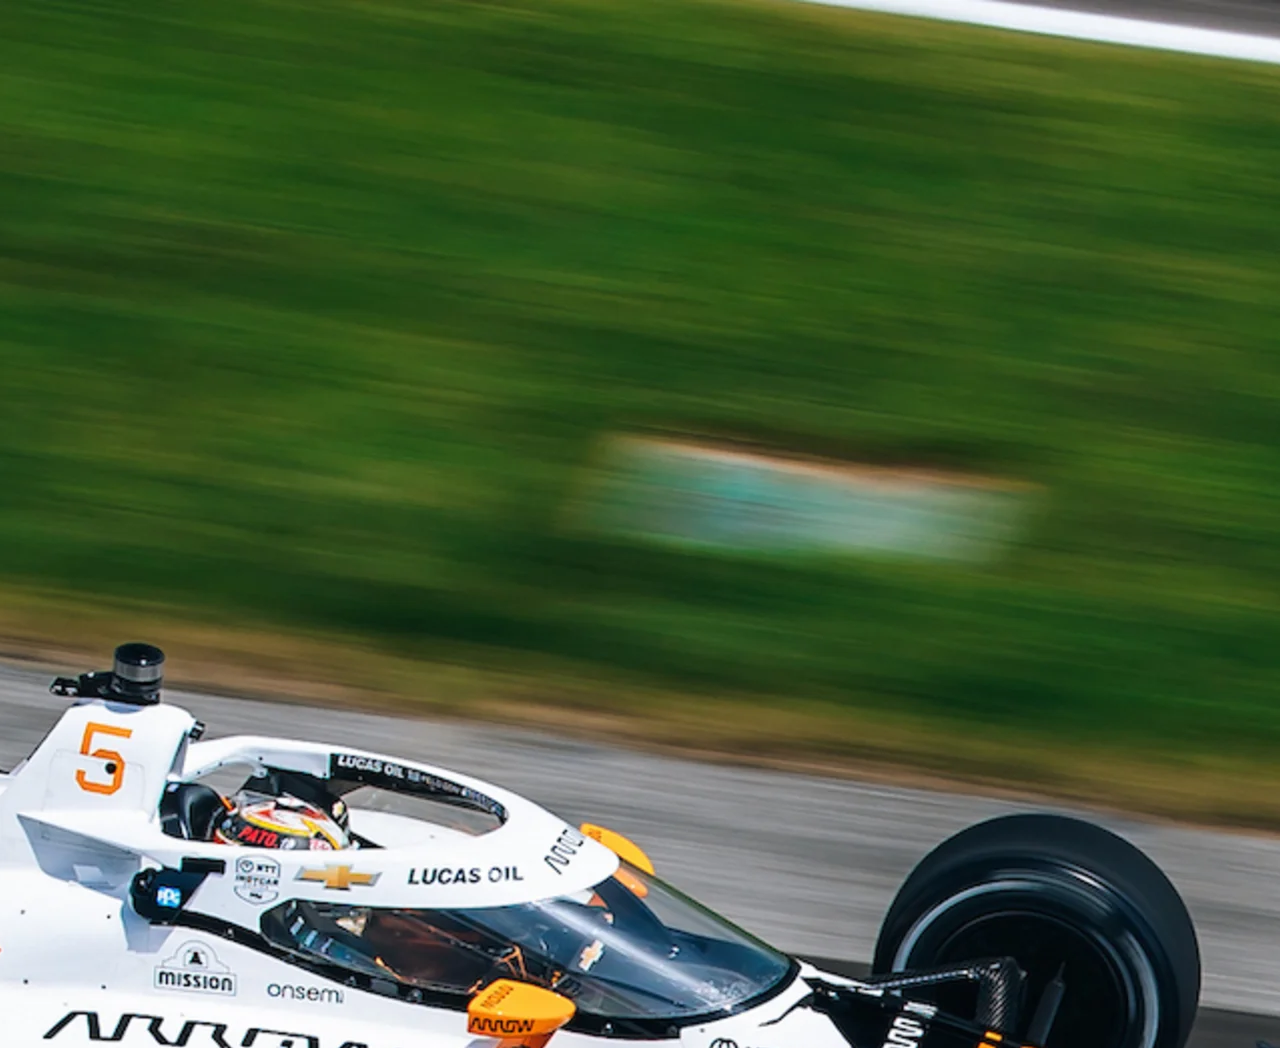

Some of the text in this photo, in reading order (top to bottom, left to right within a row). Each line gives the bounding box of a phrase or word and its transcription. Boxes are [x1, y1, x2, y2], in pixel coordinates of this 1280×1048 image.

[75, 721, 133, 795] 5
[338, 755, 382, 773] LUCAS
[384, 764, 405, 779] OIL
[408, 866, 524, 885] LUCAS OIL
[267, 983, 345, 1003] onsemi
[470, 1017, 535, 1033] ARROW
